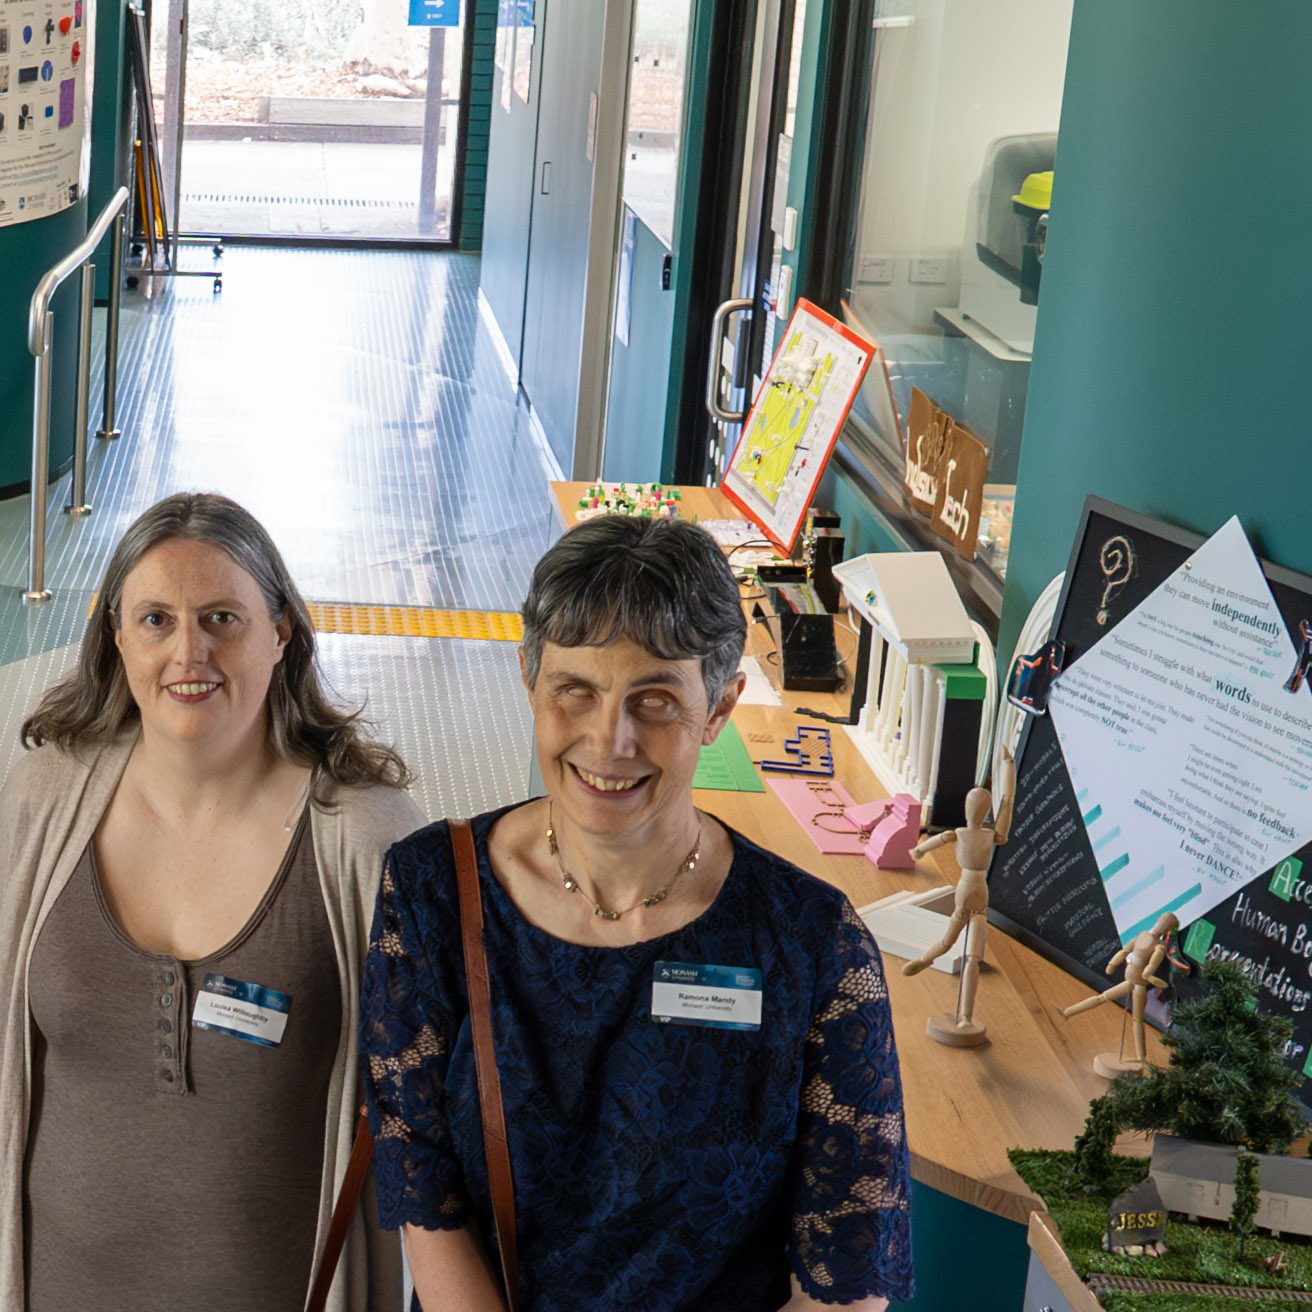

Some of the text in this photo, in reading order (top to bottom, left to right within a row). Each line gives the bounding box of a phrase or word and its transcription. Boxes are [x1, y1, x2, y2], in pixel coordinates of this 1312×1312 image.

[940, 459, 970, 540] Tech
[1179, 592, 1191, 600] can
[1209, 599, 1283, 639] independently
[1227, 590, 1270, 610] environment
[1213, 618, 1239, 633] without
[1099, 647, 1133, 670] something
[1132, 662, 1140, 671] to
[1140, 667, 1168, 683] someone
[1169, 678, 1185, 691] who
[1184, 685, 1197, 696] has
[1196, 693, 1215, 705] never
[1216, 699, 1229, 710] had
[1230, 705, 1241, 716] the
[1242, 711, 1264, 726] vision
[1264, 721, 1273, 730] to
[1273, 727, 1285, 736] see
[1152, 652, 1180, 671] struggle
[1180, 663, 1196, 675] with
[1196, 670, 1213, 683] what
[1214, 677, 1254, 704] words
[1252, 698, 1260, 707] to
[1261, 704, 1273, 713] use
[1274, 708, 1282, 717] to
[1282, 712, 1312, 730] describe
[1101, 717, 1115, 728] NOT
[1247, 809, 1258, 819] no
[1180, 840, 1185, 849] I
[1185, 846, 1205, 861] never
[1232, 892, 1288, 945] Human
